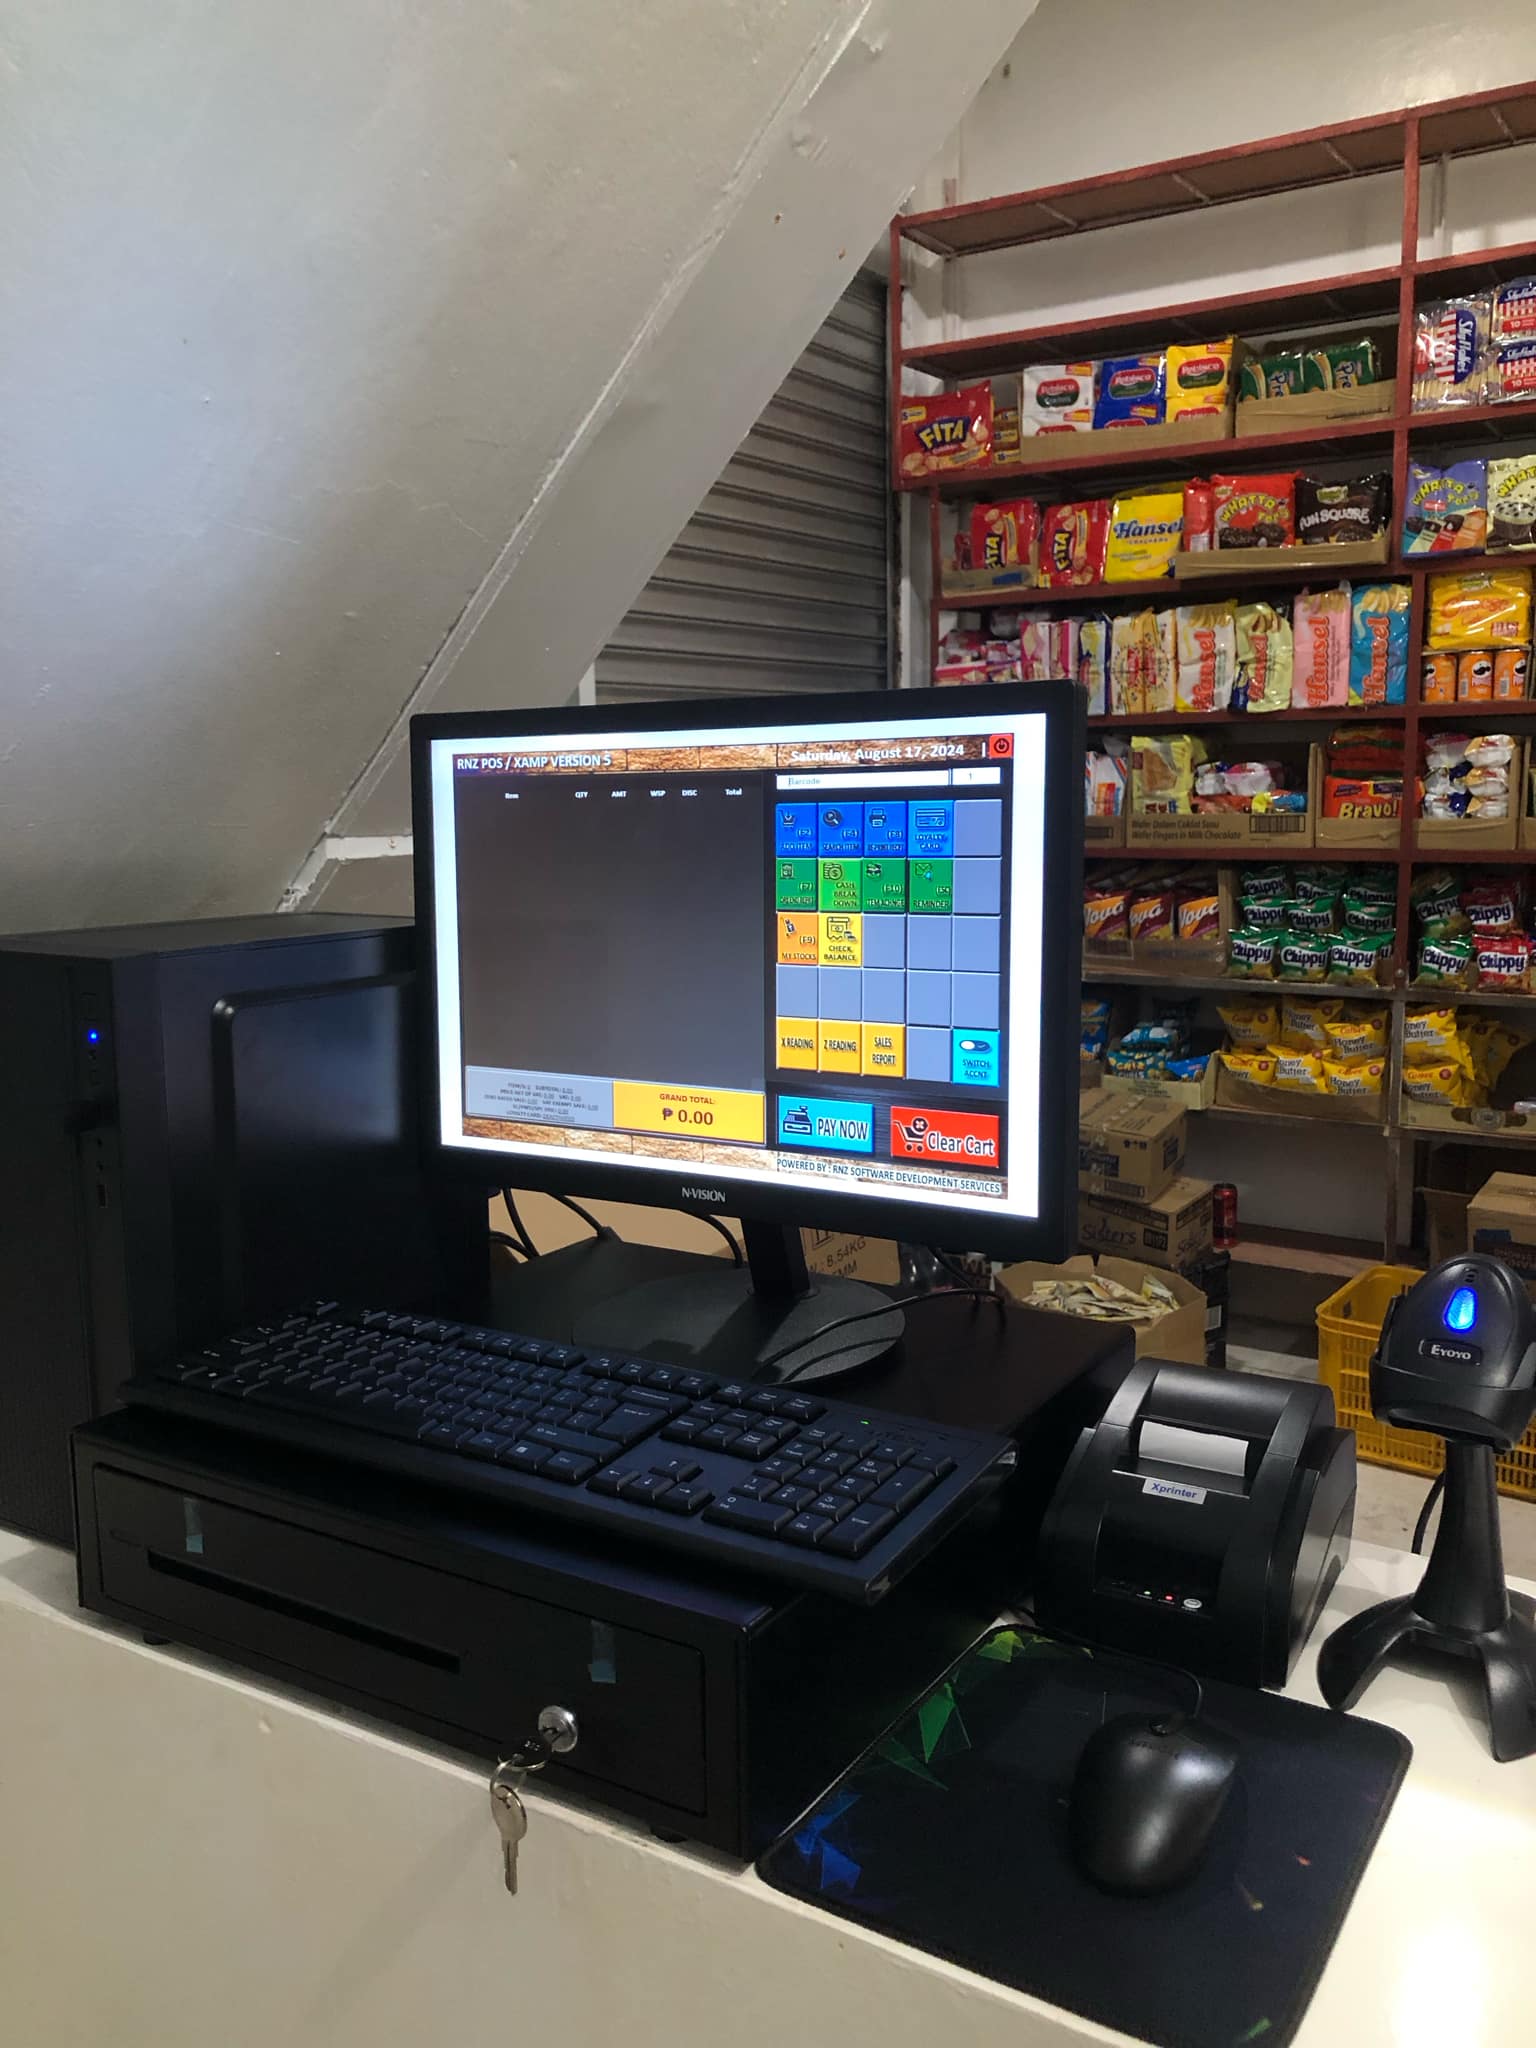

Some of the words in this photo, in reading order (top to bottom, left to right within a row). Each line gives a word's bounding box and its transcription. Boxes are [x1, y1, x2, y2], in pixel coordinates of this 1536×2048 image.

[919, 419, 965, 450] FITA
[1114, 517, 1183, 540] Hansel
[1054, 533, 1070, 571] FITA
[1307, 616, 1330, 707] Hansel
[1362, 616, 1390, 704] Hansel
[457, 757, 480, 770] RNZ
[481, 757, 503, 769] POS
[505, 756, 512, 770] /
[514, 755, 548, 768] XAMP
[550, 754, 601, 767] VERSION
[603, 754, 612, 766] 5
[790, 750, 852, 764] Saturday,
[855, 748, 902, 761] August
[904, 747, 927, 760] 17,
[930, 744, 964, 758] 2024
[575, 791, 588, 799] QTY
[611, 790, 627, 798] AMT
[681, 789, 698, 797] DISC
[725, 788, 742, 796] Total
[1340, 799, 1398, 819] Bravo!
[1204, 831, 1241, 840] Chocolate
[834, 899, 858, 907] DOWN
[1468, 903, 1511, 924] Chippy
[793, 952, 817, 960] STOCKS
[824, 953, 857, 961] BALANCE
[828, 945, 852, 953] CHECK
[1234, 942, 1273, 963] Chippy
[1284, 949, 1326, 968] Chippy
[1333, 948, 1375, 968] Chippy
[1424, 949, 1467, 972] Chippy
[1480, 954, 1525, 972] Chippy
[1290, 1019, 1316, 1031] Butter
[787, 1038, 814, 1050] READING
[828, 1040, 857, 1052] READING
[874, 1037, 893, 1049] SALES
[1334, 1036, 1367, 1047] Honey
[1343, 1043, 1374, 1054] Butter
[872, 1054, 896, 1066] REPORT
[1279, 1065, 1308, 1076] Butter
[1330, 1077, 1361, 1088] Honey
[1337, 1084, 1367, 1095] Butter
[659, 1093, 688, 1104] GRAND
[678, 1109, 714, 1125] 0.00
[817, 1118, 838, 1138] PAY
[839, 1120, 869, 1141] NOW
[927, 1132, 962, 1153] Clear
[965, 1135, 996, 1156] Cart
[777, 1159, 816, 1171] POWERED
[817, 1162, 827, 1173] BY
[832, 1164, 849, 1175] RNZ
[850, 1167, 895, 1181] SOFTWARE
[896, 1172, 959, 1189] DEVELOPMENT
[960, 1180, 1001, 1194] SERVICES
[1151, 1482, 1198, 1500] Xprinter
